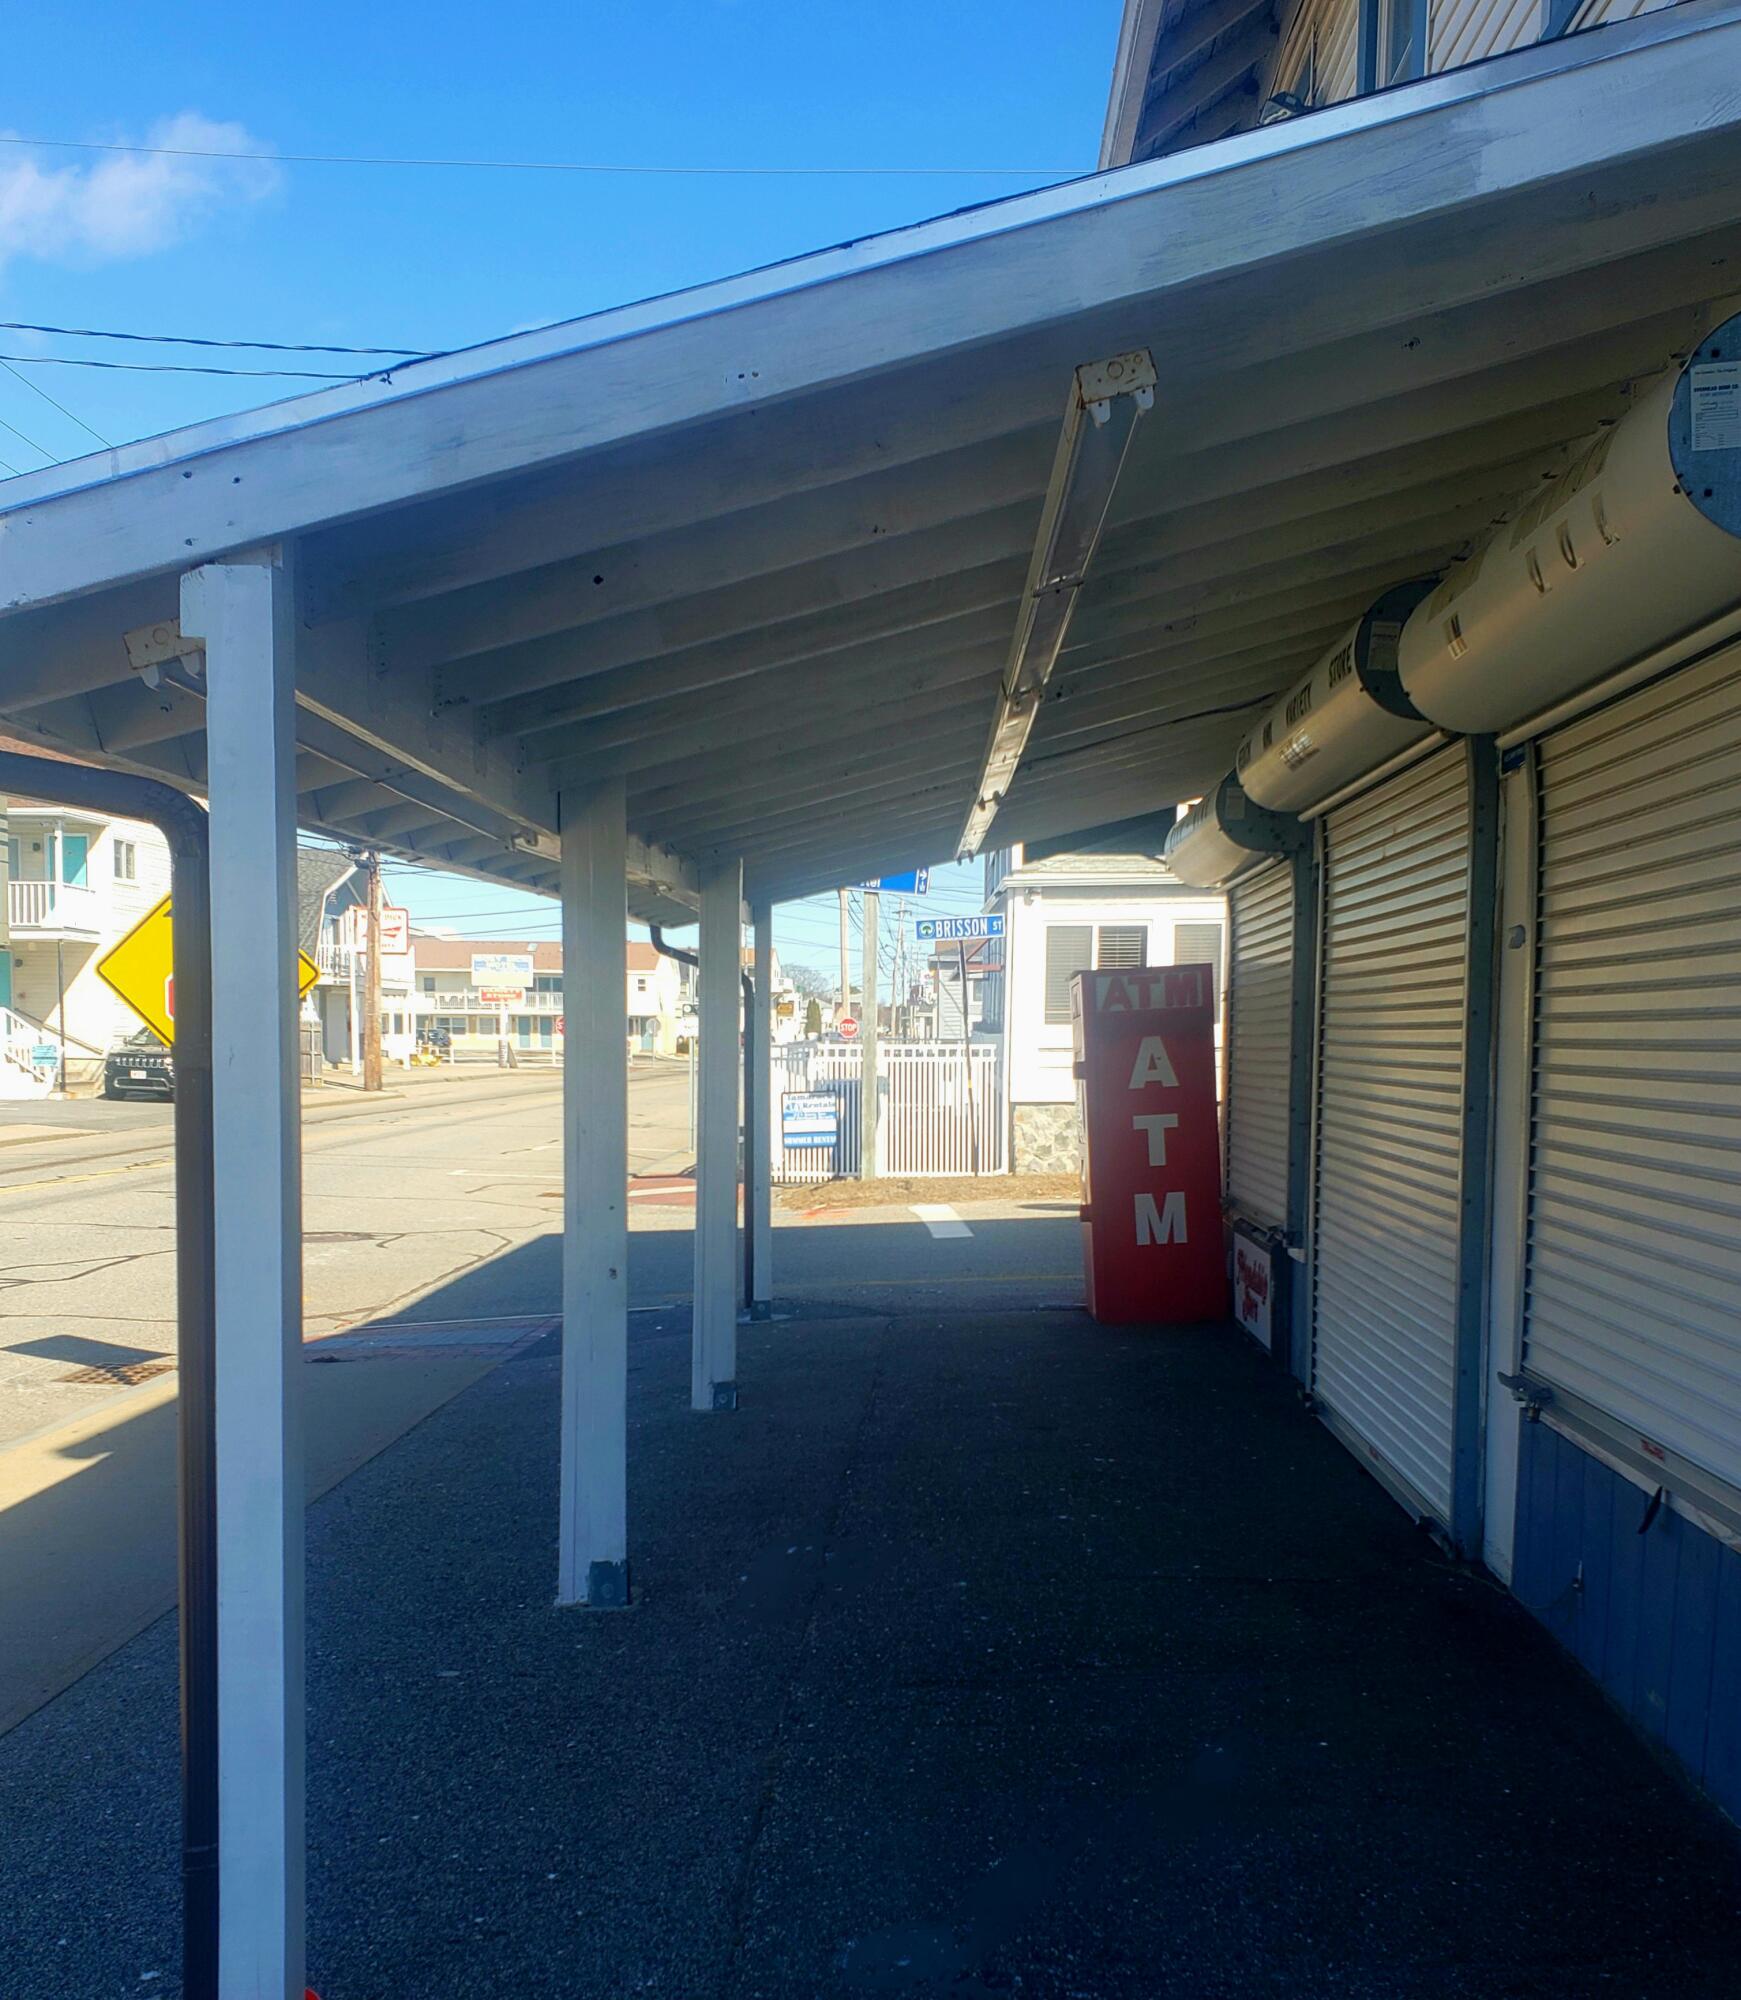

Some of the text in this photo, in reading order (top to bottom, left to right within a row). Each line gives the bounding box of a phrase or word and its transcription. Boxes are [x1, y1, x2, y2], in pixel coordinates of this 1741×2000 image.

[935, 918, 1002, 938] BRISSON ST
[1103, 973, 1198, 1011] ATM
[840, 1022, 857, 1033] STOP
[1128, 1036, 1188, 1246] ATM
